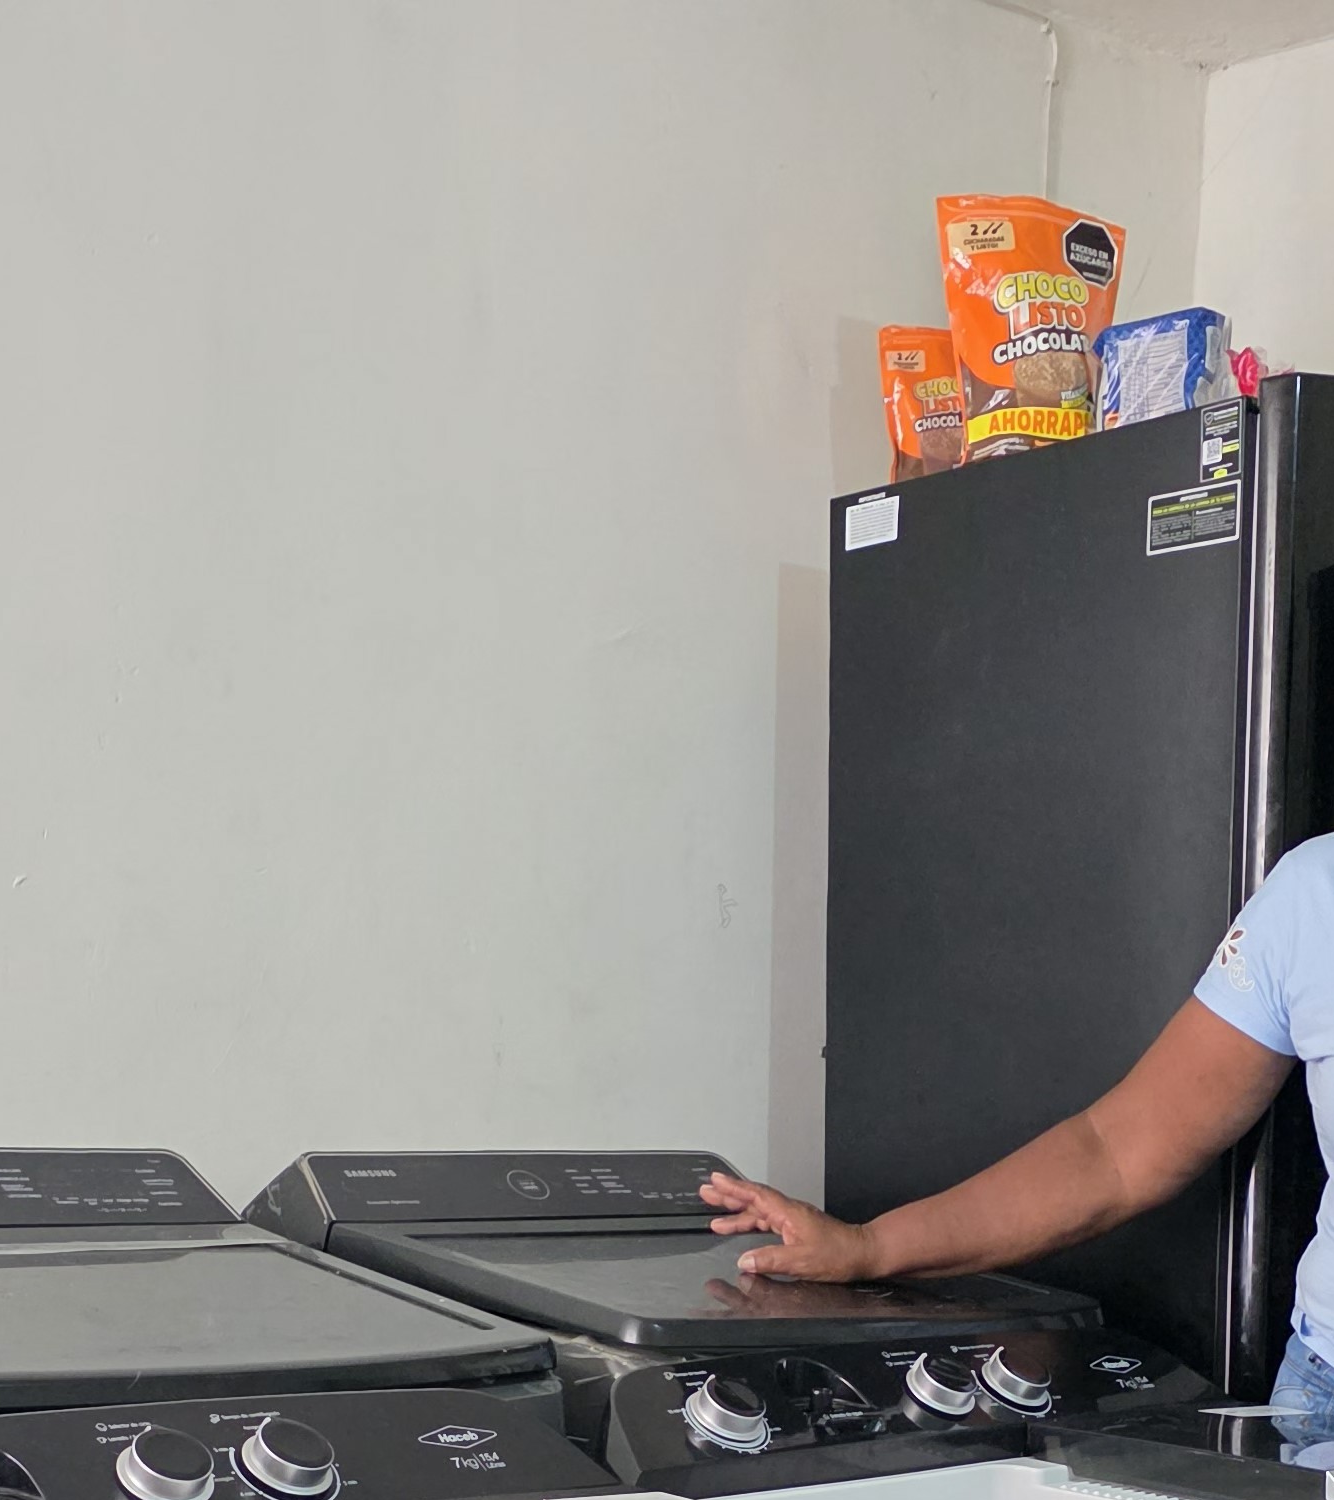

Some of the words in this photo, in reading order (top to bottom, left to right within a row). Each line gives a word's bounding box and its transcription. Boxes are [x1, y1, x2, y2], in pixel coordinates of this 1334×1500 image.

[970, 223, 979, 236] 2
[1070, 242, 1098, 258] EXCESO
[1098, 250, 1109, 260] EN
[996, 272, 1087, 309] CHOCO
[1012, 301, 1084, 337] LISTO
[344, 1169, 397, 1178] SAMSUNG
[438, 1430, 479, 1443] Haceb
